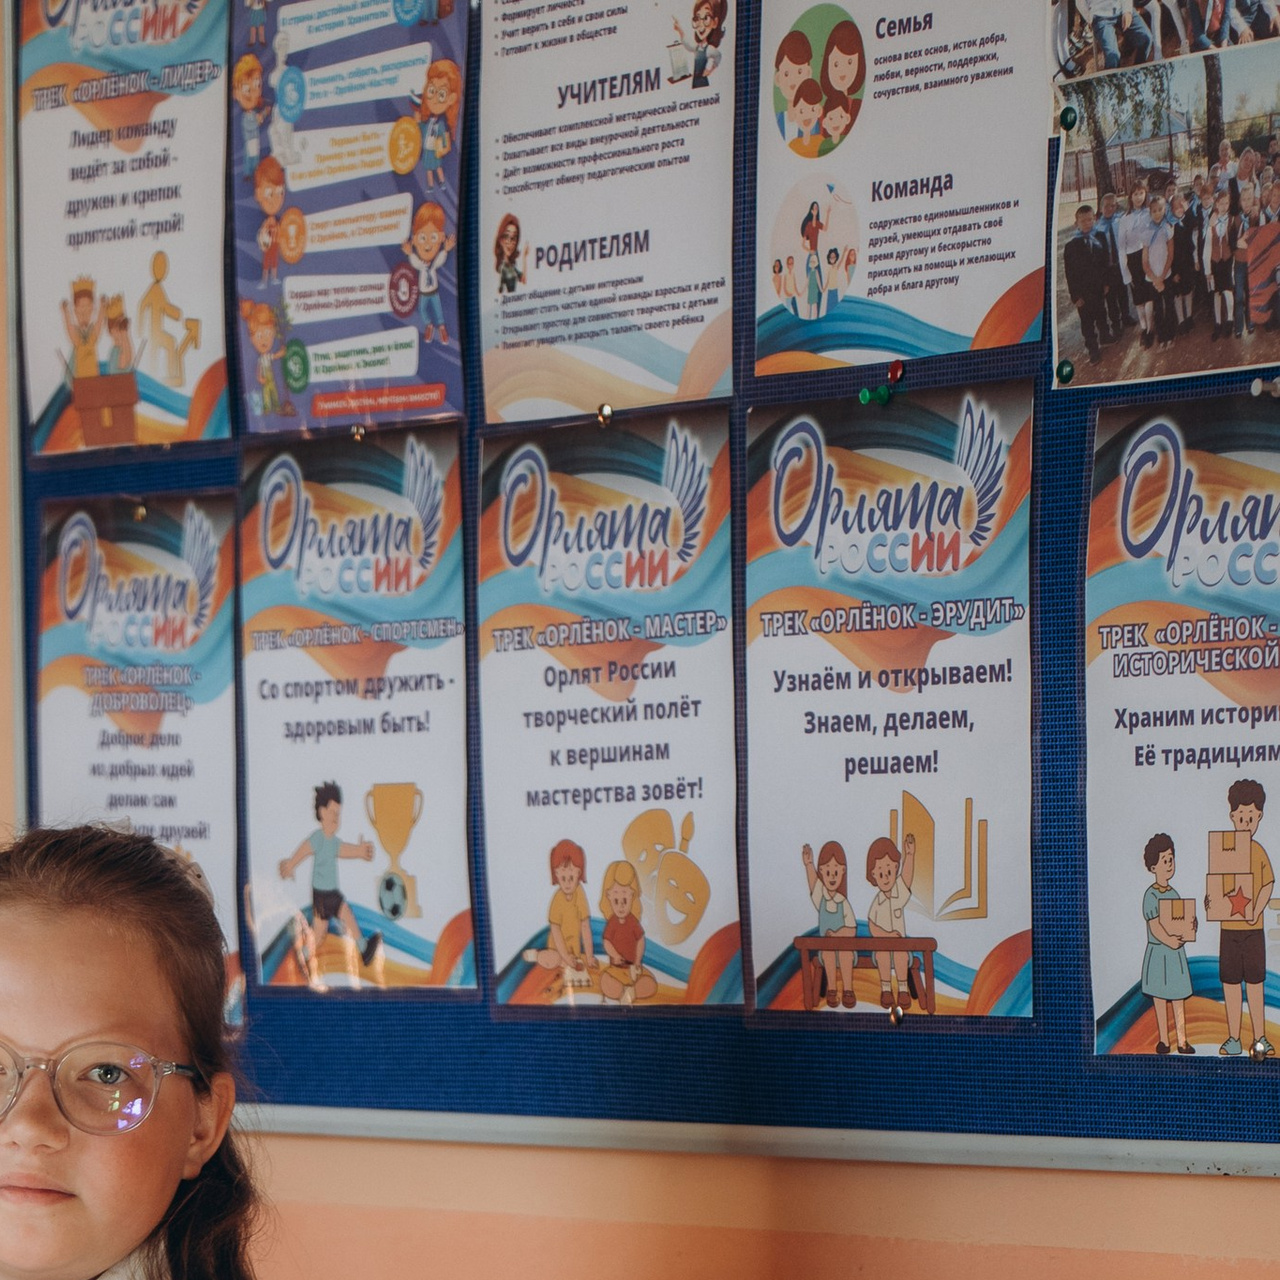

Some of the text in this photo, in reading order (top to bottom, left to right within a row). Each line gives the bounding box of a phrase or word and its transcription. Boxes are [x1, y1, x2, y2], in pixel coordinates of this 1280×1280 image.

[606, 5, 628, 17] силы
[875, 12, 933, 39] Семья
[874, 32, 1007, 66] основа всех основ, исток добра,
[873, 52, 999, 83] любви, верности, поддержки,
[873, 66, 1014, 100] сочувствия, взаимного уважения
[557, 67, 661, 109] УЧИТЕЛЯМ
[616, 101, 677, 122] методической
[679, 93, 720, 111] системой
[69, 118, 178, 150] Лидер команду
[590, 126, 639, 145] внеурочной
[641, 118, 700, 137] деятельности
[661, 138, 685, 153] роста
[657, 155, 690, 168] опытом
[64, 194, 117, 219] дружен
[132, 184, 182, 209] крепок
[871, 172, 953, 202] Команда
[869, 199, 1019, 230] содружество единомышленников и
[66, 218, 138, 251] орлятский
[868, 216, 1003, 248] друзей, умеющих отдавать своё
[535, 229, 650, 272] РОДИТЕЛЯМ
[867, 250, 1016, 281] приходить на помощь и желающих
[868, 237, 992, 264] время другому и бескорыстно
[701, 276, 726, 292] детей
[867, 275, 960, 297] добра и блага другому
[773, 421, 964, 559] Орлята
[263, 459, 413, 580] Орлята
[504, 449, 671, 578] Орлята
[819, 530, 961, 575] РОССИИ
[543, 548, 669, 593] РОССИИ
[492, 609, 728, 652] ТРЕК «ОРЛЁНОК МАСТЕР»
[760, 597, 1026, 637] ТРЕК «ОРЛЁНОК ЭРУДИТ»
[1099, 612, 1267, 649] ТРЕК «ОРЛЁНОК
[251, 630, 287, 651] ТРЕК
[1113, 640, 1280, 678] ИСТОРИЧЕСКОЙ
[259, 673, 445, 703] Со спортом дружить
[544, 660, 677, 692] Орлят России
[773, 658, 1012, 693] Узнаём и открываем!
[284, 709, 430, 744] здоровым быть!
[523, 695, 702, 733] творческий полёт
[804, 709, 975, 737] Знаем, делаем,
[1114, 705, 1280, 735] Храним истори
[550, 742, 670, 771] к вершинам
[845, 750, 939, 782] решаем!
[1135, 744, 1156, 766] Её
[526, 776, 703, 811] мастерства зовёт!
